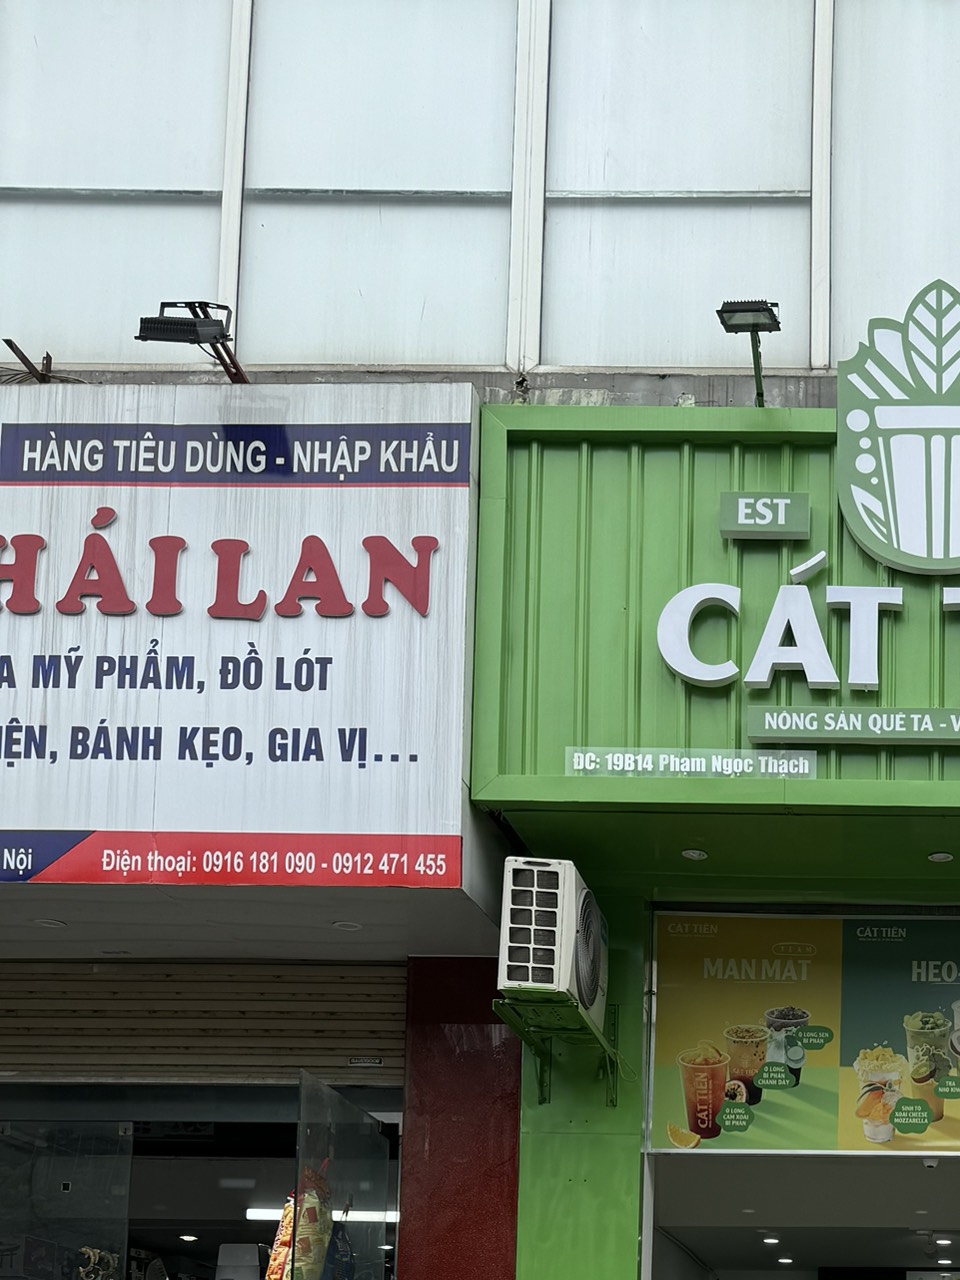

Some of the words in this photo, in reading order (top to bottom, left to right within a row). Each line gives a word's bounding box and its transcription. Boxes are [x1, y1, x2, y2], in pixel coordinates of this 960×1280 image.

[22, 431, 104, 472] HÀNG
[113, 431, 176, 473] TIÊU
[185, 432, 267, 473] DÙNG
[275, 457, 285, 465] -
[292, 435, 371, 481] NHẬP
[379, 432, 459, 474] KHẨU
[737, 498, 789, 526] EST
[206, 534, 440, 622] LAN
[656, 550, 903, 692] CÁT
[32, 645, 84, 689] MỸ
[95, 638, 206, 694] PHẨM,
[219, 641, 263, 692] ĐỒ
[275, 646, 333, 692] LÓT
[764, 709, 818, 732] NÔNG
[824, 708, 862, 733] SẢN
[868, 710, 906, 735] QUÊ
[910, 715, 933, 732] TA
[69, 719, 162, 761] BÁNH
[178, 726, 254, 768] KẸO,
[268, 728, 325, 762] GIA
[573, 752, 600, 770] ĐC:
[605, 753, 654, 771] 19B14
[659, 754, 706, 775] Phạm
[711, 755, 753, 776] Ngọc
[758, 756, 809, 777] Thạch
[3, 848, 33, 872] Nội
[101, 849, 142, 878] Điện
[147, 849, 197, 878] thoại:
[202, 850, 243, 874] 0916
[249, 850, 279, 874] 181
[284, 851, 316, 875] 090
[332, 851, 374, 875] 0912
[378, 852, 409, 876] 471
[415, 852, 446, 876] 455
[780, 945, 813, 953] TEAM
